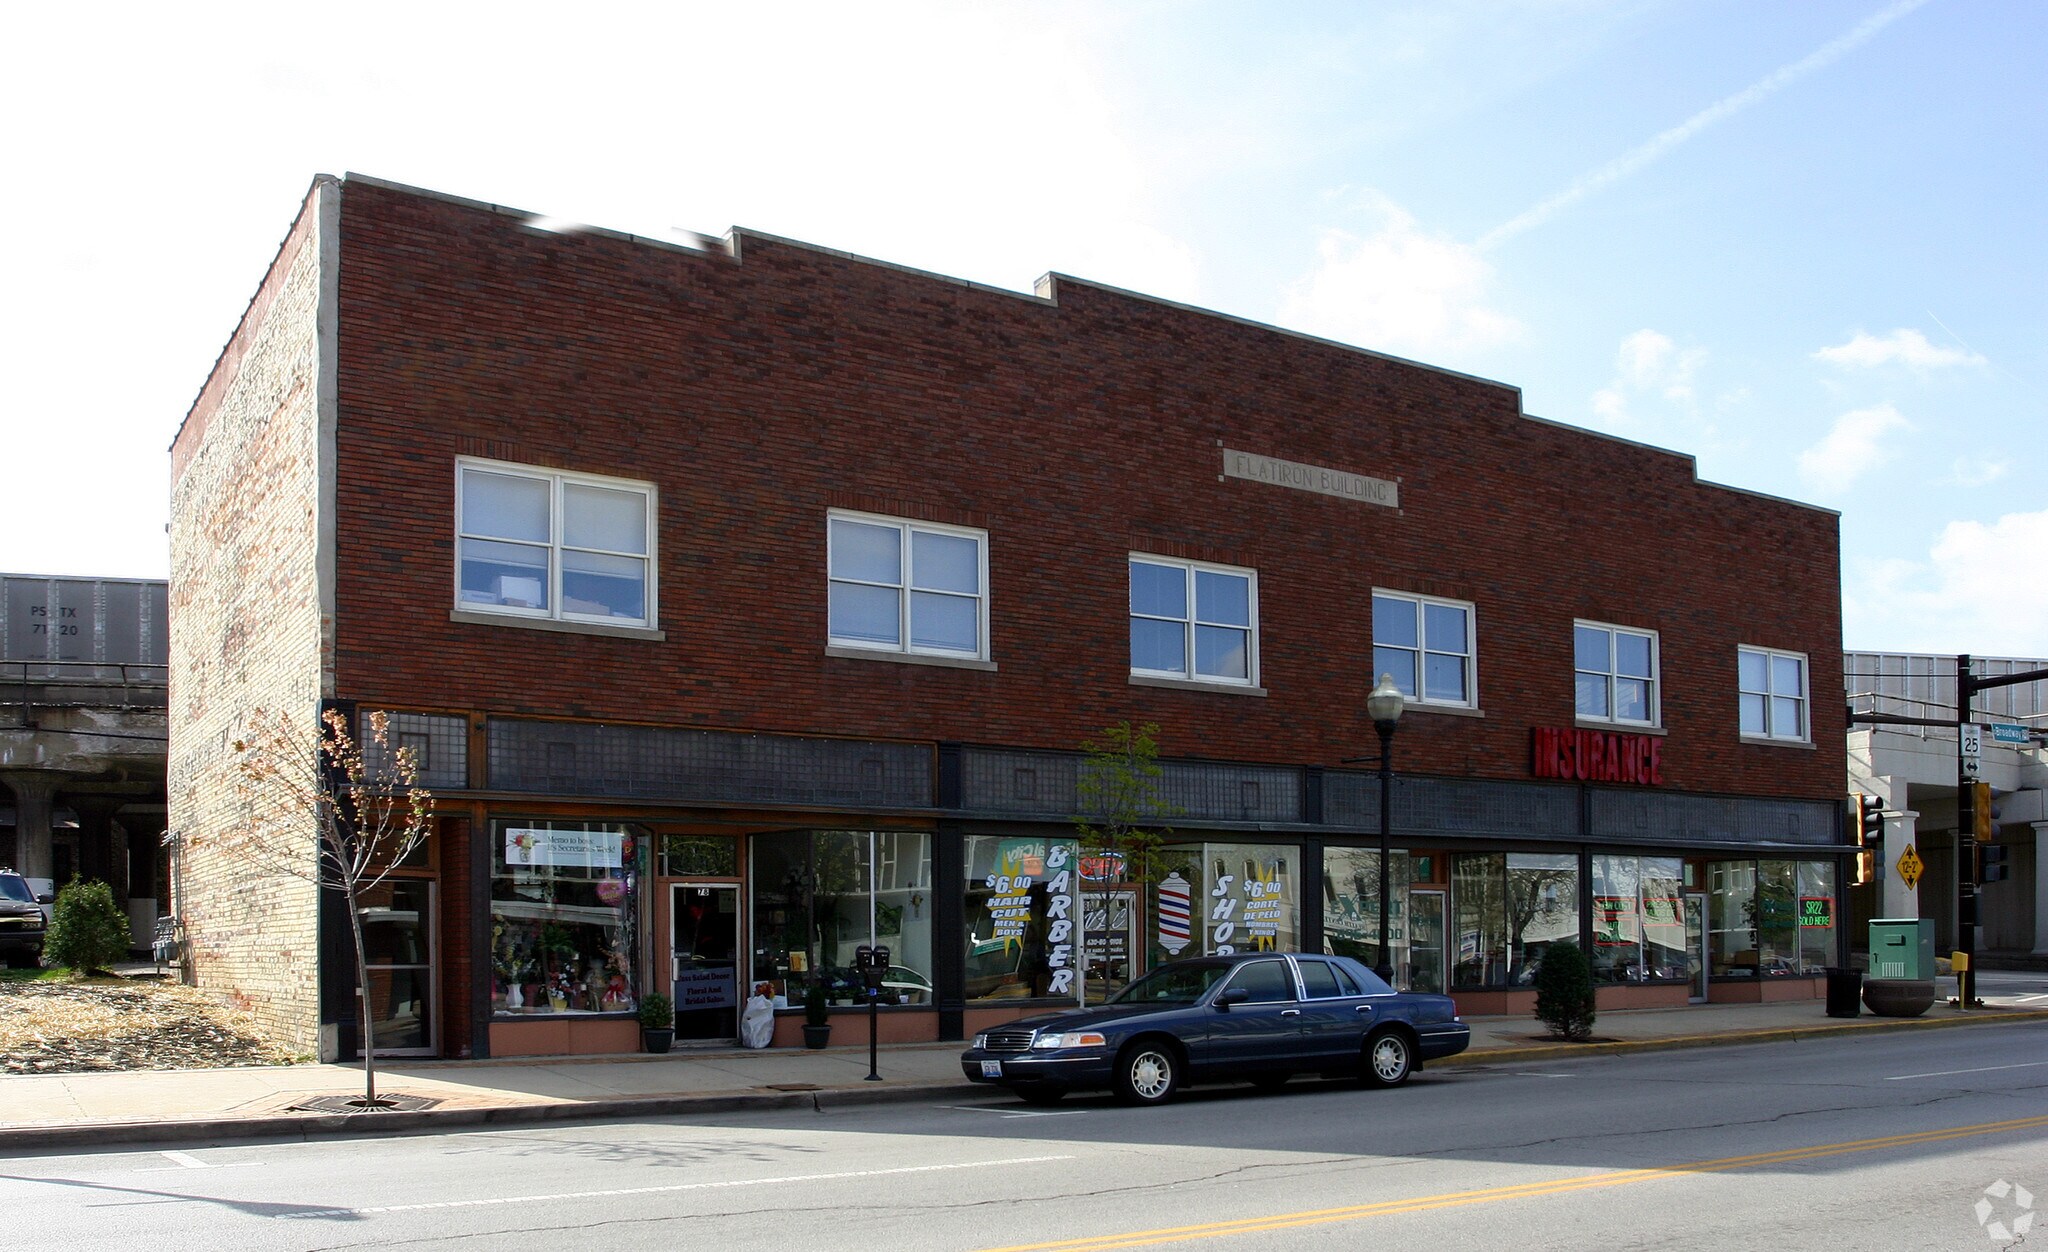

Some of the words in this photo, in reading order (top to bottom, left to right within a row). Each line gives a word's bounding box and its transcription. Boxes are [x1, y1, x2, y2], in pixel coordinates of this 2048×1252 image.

[1236, 455, 1312, 486] FLATIRON
[1320, 472, 1387, 501] BUILDING
[60, 607, 77, 618] TX
[60, 625, 78, 636] 20
[1964, 737, 1979, 752] 25
[1533, 726, 1664, 785] INSURANCE
[985, 874, 1032, 894] $6.00
[1243, 879, 1281, 898] $6.00
[986, 896, 1032, 907] HAIR
[1246, 900, 1279, 909] CORTE
[1331, 893, 1402, 920] EXPET
[1805, 900, 1823, 914] SR22
[990, 907, 1030, 919] CUT
[1046, 845, 1074, 994] BARBER
[1243, 912, 1257, 920] DE
[1258, 910, 1281, 919] PELO
[1815, 915, 1830, 926] HERE
[996, 928, 1023, 936] BOYS
